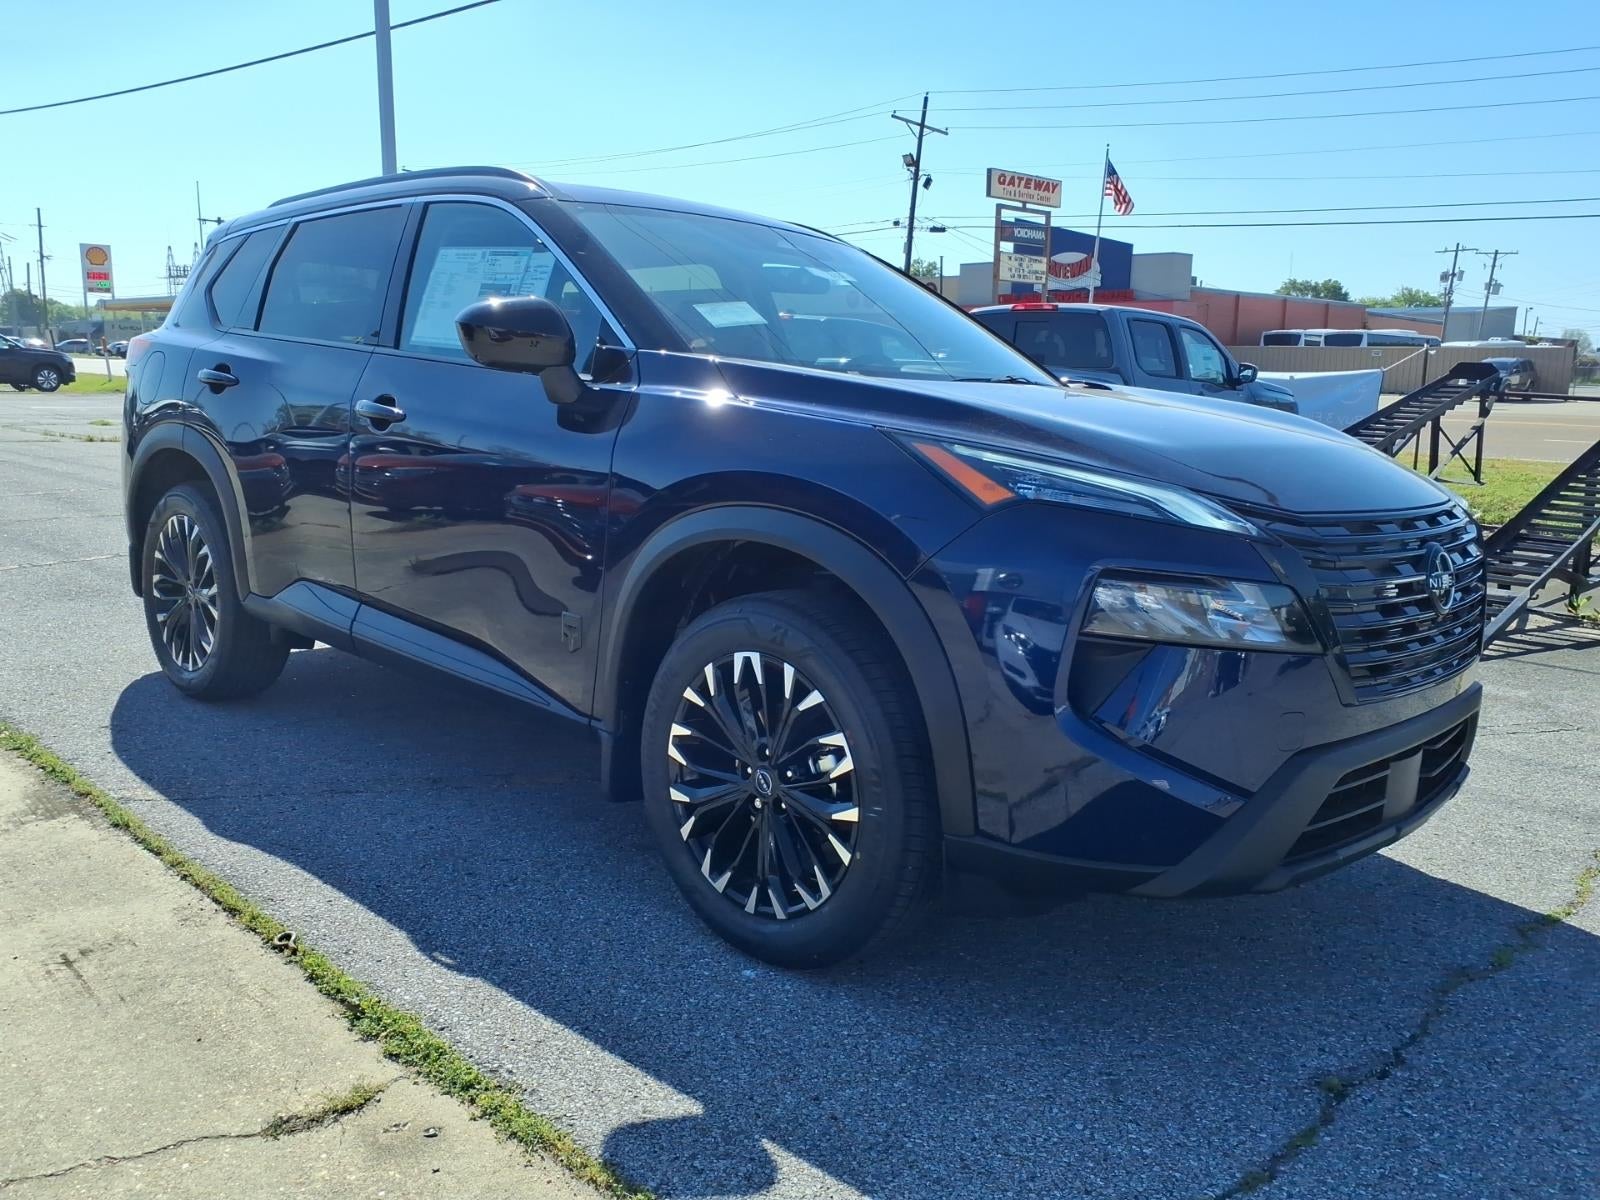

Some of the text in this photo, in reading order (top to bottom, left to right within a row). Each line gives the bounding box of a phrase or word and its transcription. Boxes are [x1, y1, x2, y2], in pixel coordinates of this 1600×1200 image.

[997, 173, 1059, 194] GATEWAY
[1002, 187, 1012, 197] Tire
[1013, 226, 1046, 240] YOKOHAMA
[1048, 253, 1093, 280] ATEWAY
